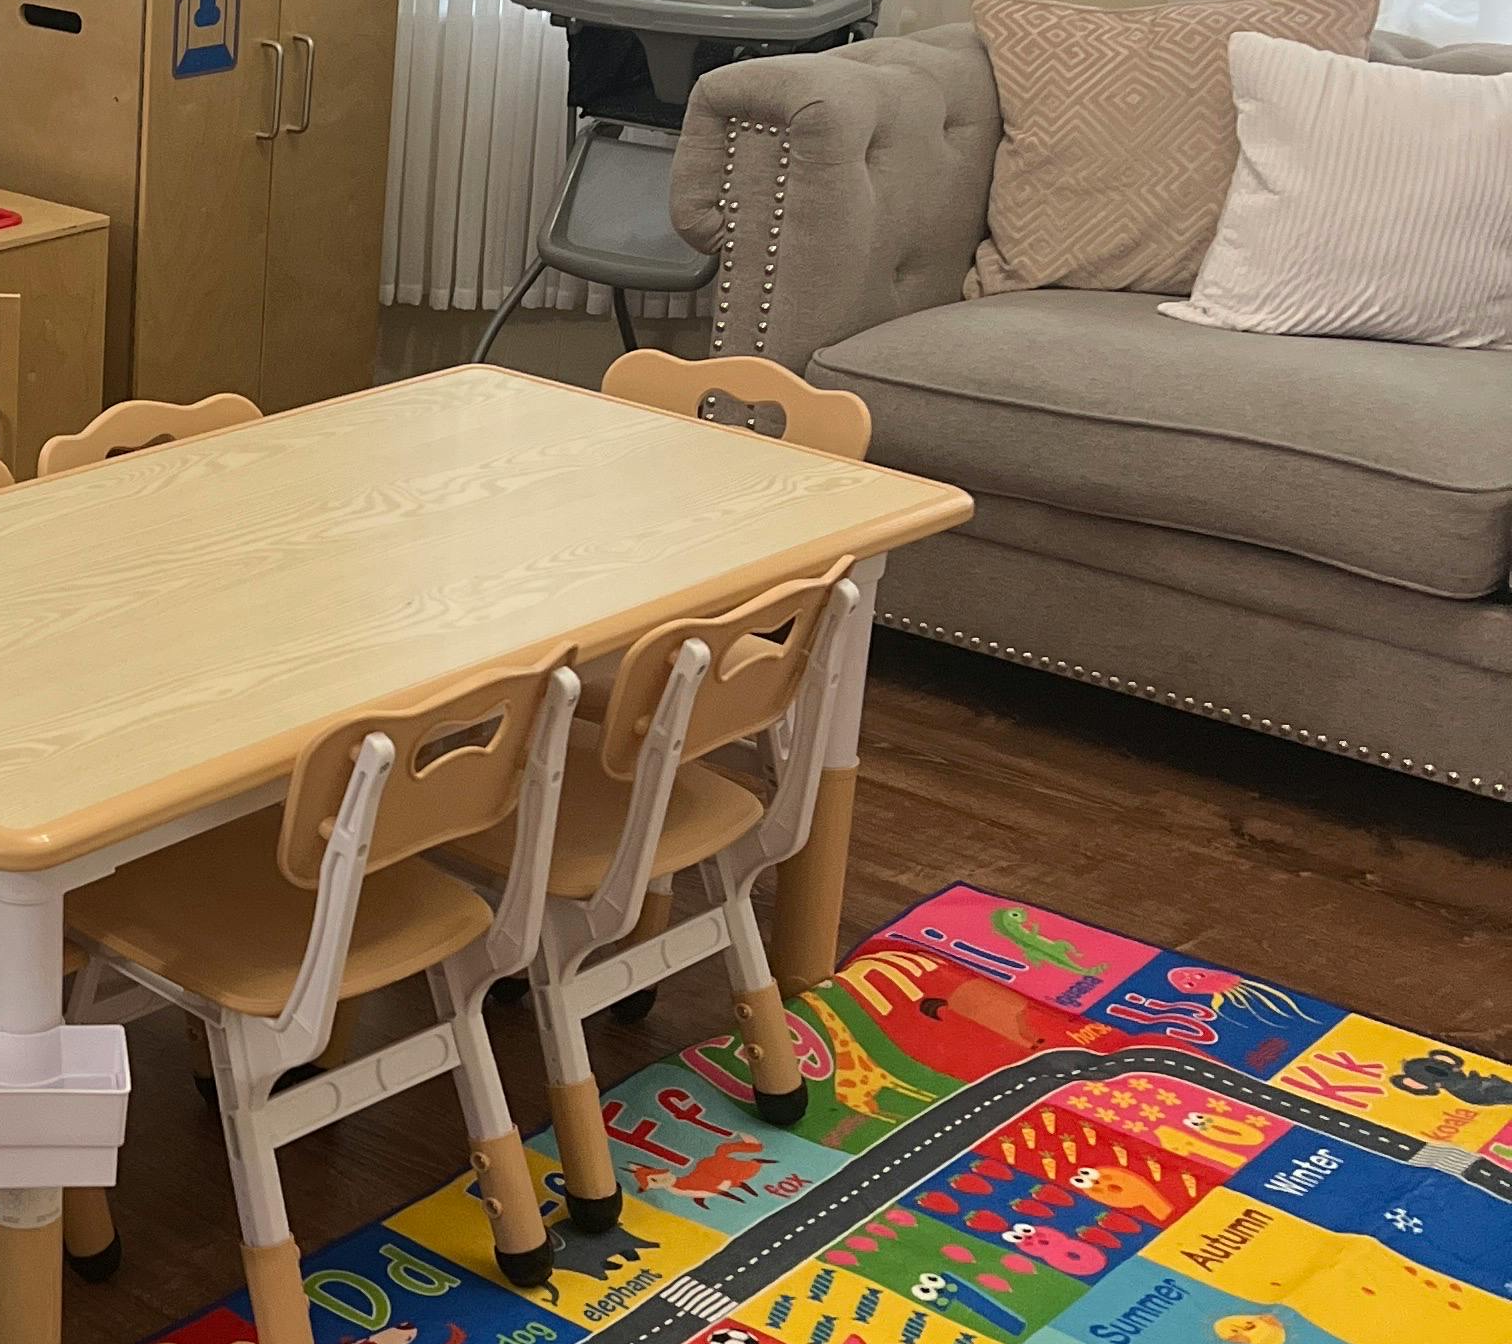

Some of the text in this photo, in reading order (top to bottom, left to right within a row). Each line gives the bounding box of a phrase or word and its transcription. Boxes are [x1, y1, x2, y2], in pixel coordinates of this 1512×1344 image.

[1106, 992, 1219, 1045] Jj
[1279, 1050, 1387, 1111] Kk
[1420, 1107, 1480, 1142] koala
[764, 1172, 813, 1199] fox
[1264, 1148, 1344, 1197] Winter
[1180, 1205, 1274, 1273] Autumn
[304, 1244, 461, 1332] Dd
[583, 1265, 662, 1324] elephant
